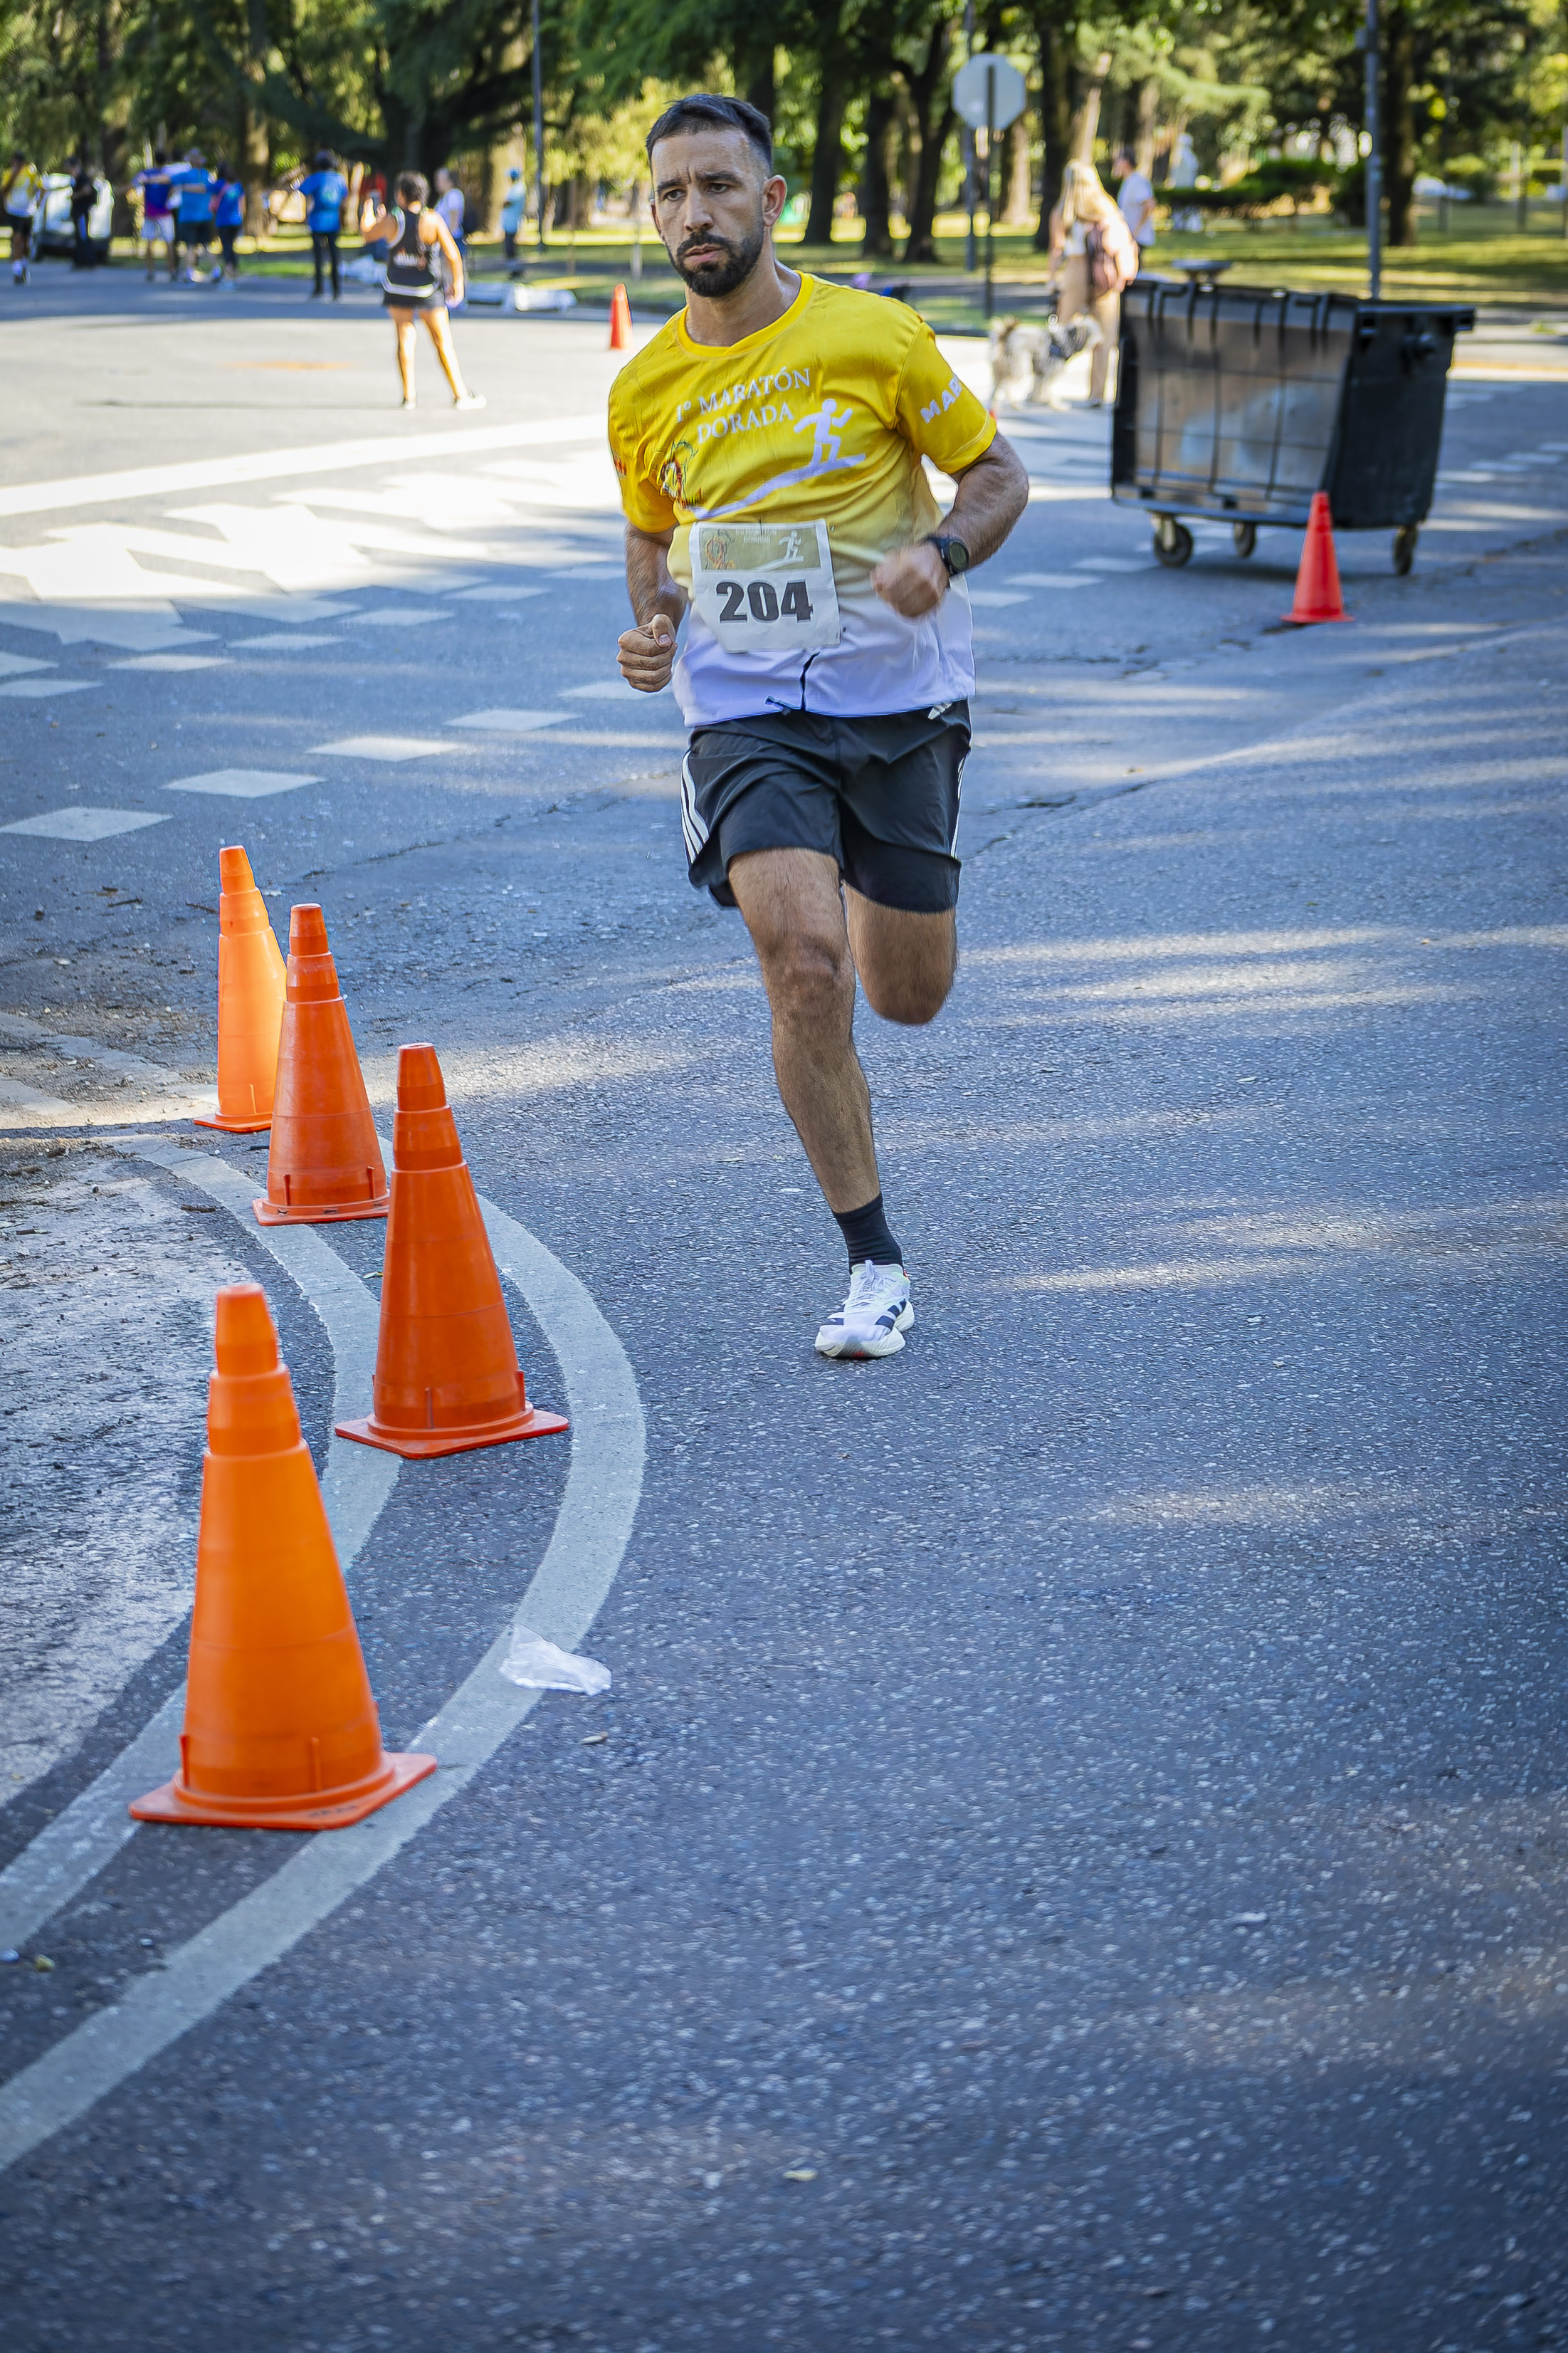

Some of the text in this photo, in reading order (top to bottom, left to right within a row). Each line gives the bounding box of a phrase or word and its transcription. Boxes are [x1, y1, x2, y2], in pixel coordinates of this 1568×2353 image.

[698, 366, 811, 415] MARATÓN
[697, 402, 794, 444] DORADA
[716, 580, 814, 623] 204
